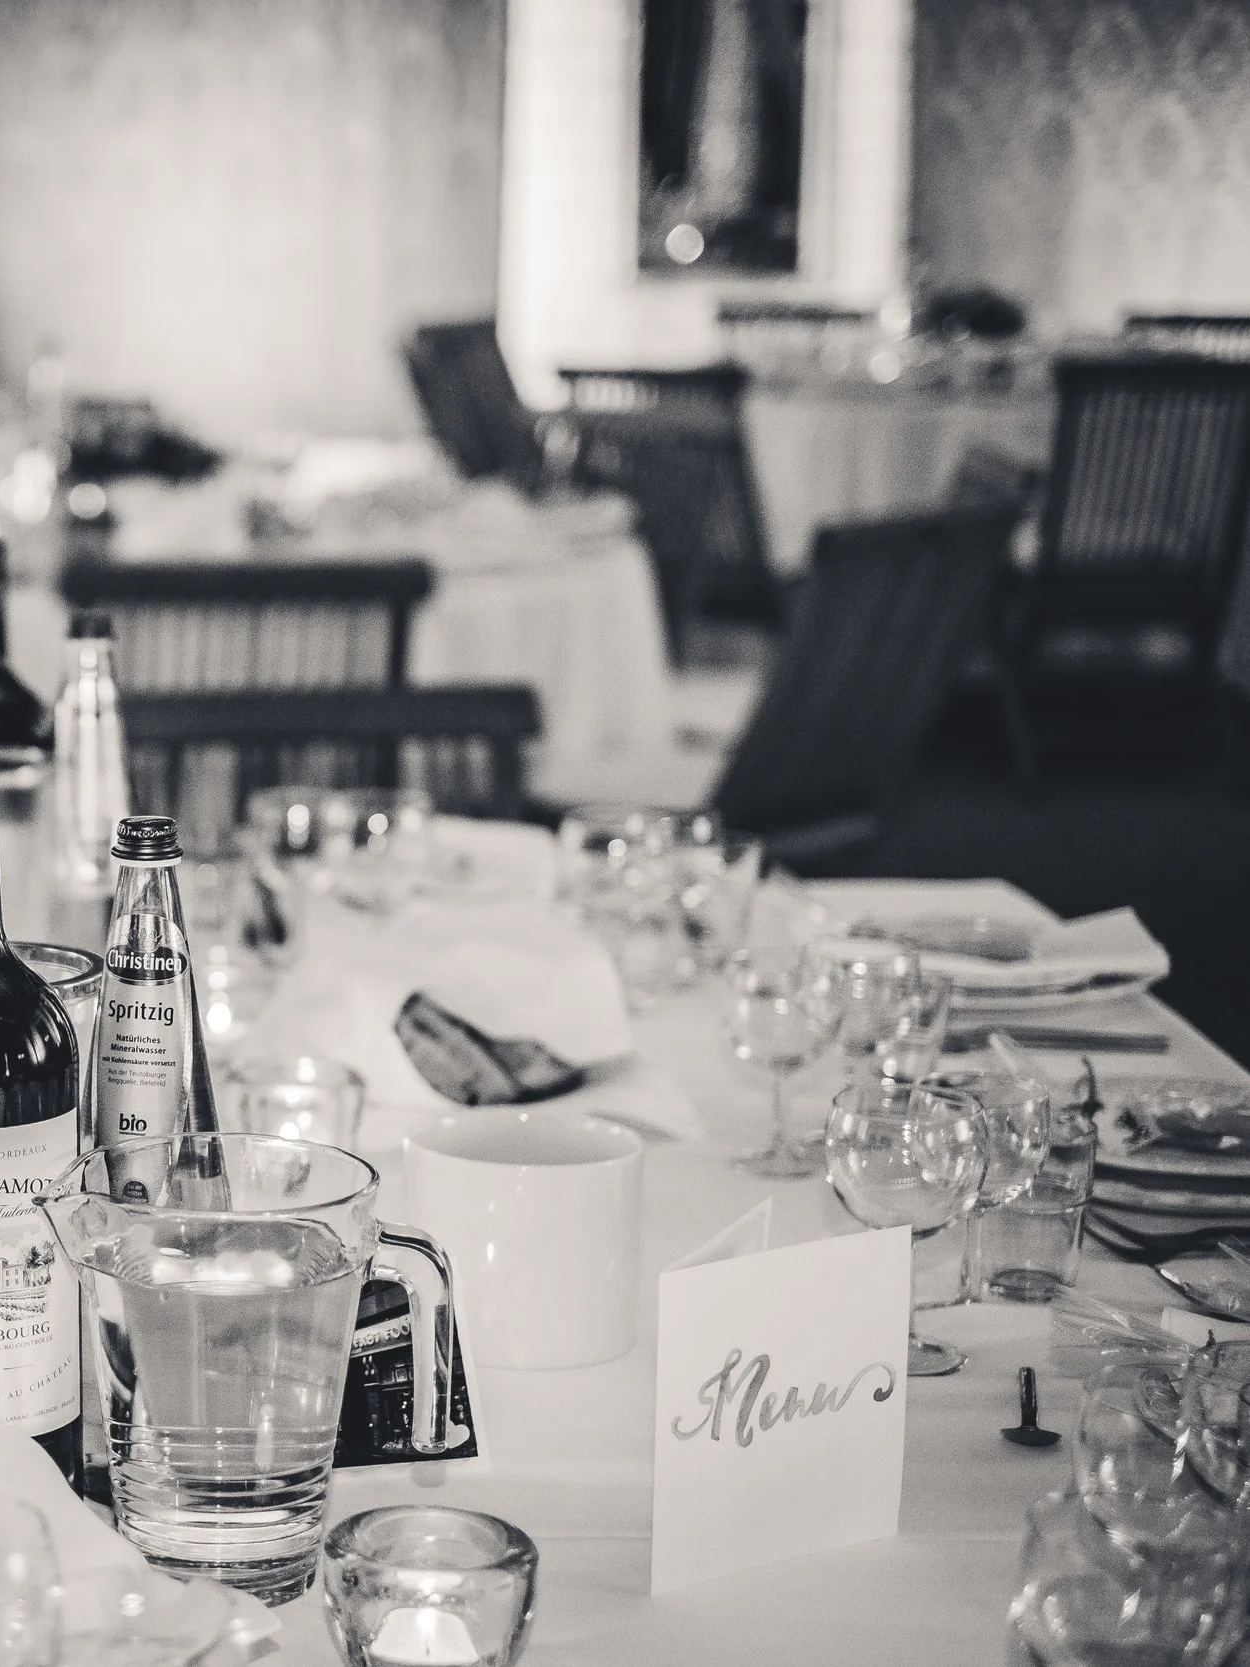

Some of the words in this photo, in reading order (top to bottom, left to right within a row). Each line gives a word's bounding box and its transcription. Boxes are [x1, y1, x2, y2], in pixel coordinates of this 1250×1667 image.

[108, 949, 182, 972] Christinen
[108, 1000, 174, 1026] Spritzig
[116, 1033, 161, 1044] Natürliches
[110, 1043, 166, 1054] Mineralwasser
[111, 1056, 149, 1066] Kohlensäure
[119, 1113, 147, 1131] bio
[381, 1322, 411, 1341] FOO
[7, 1388, 23, 1399] AU
[29, 1355, 73, 1392] CHÂTEAU
[671, 1347, 897, 1448] Menu
